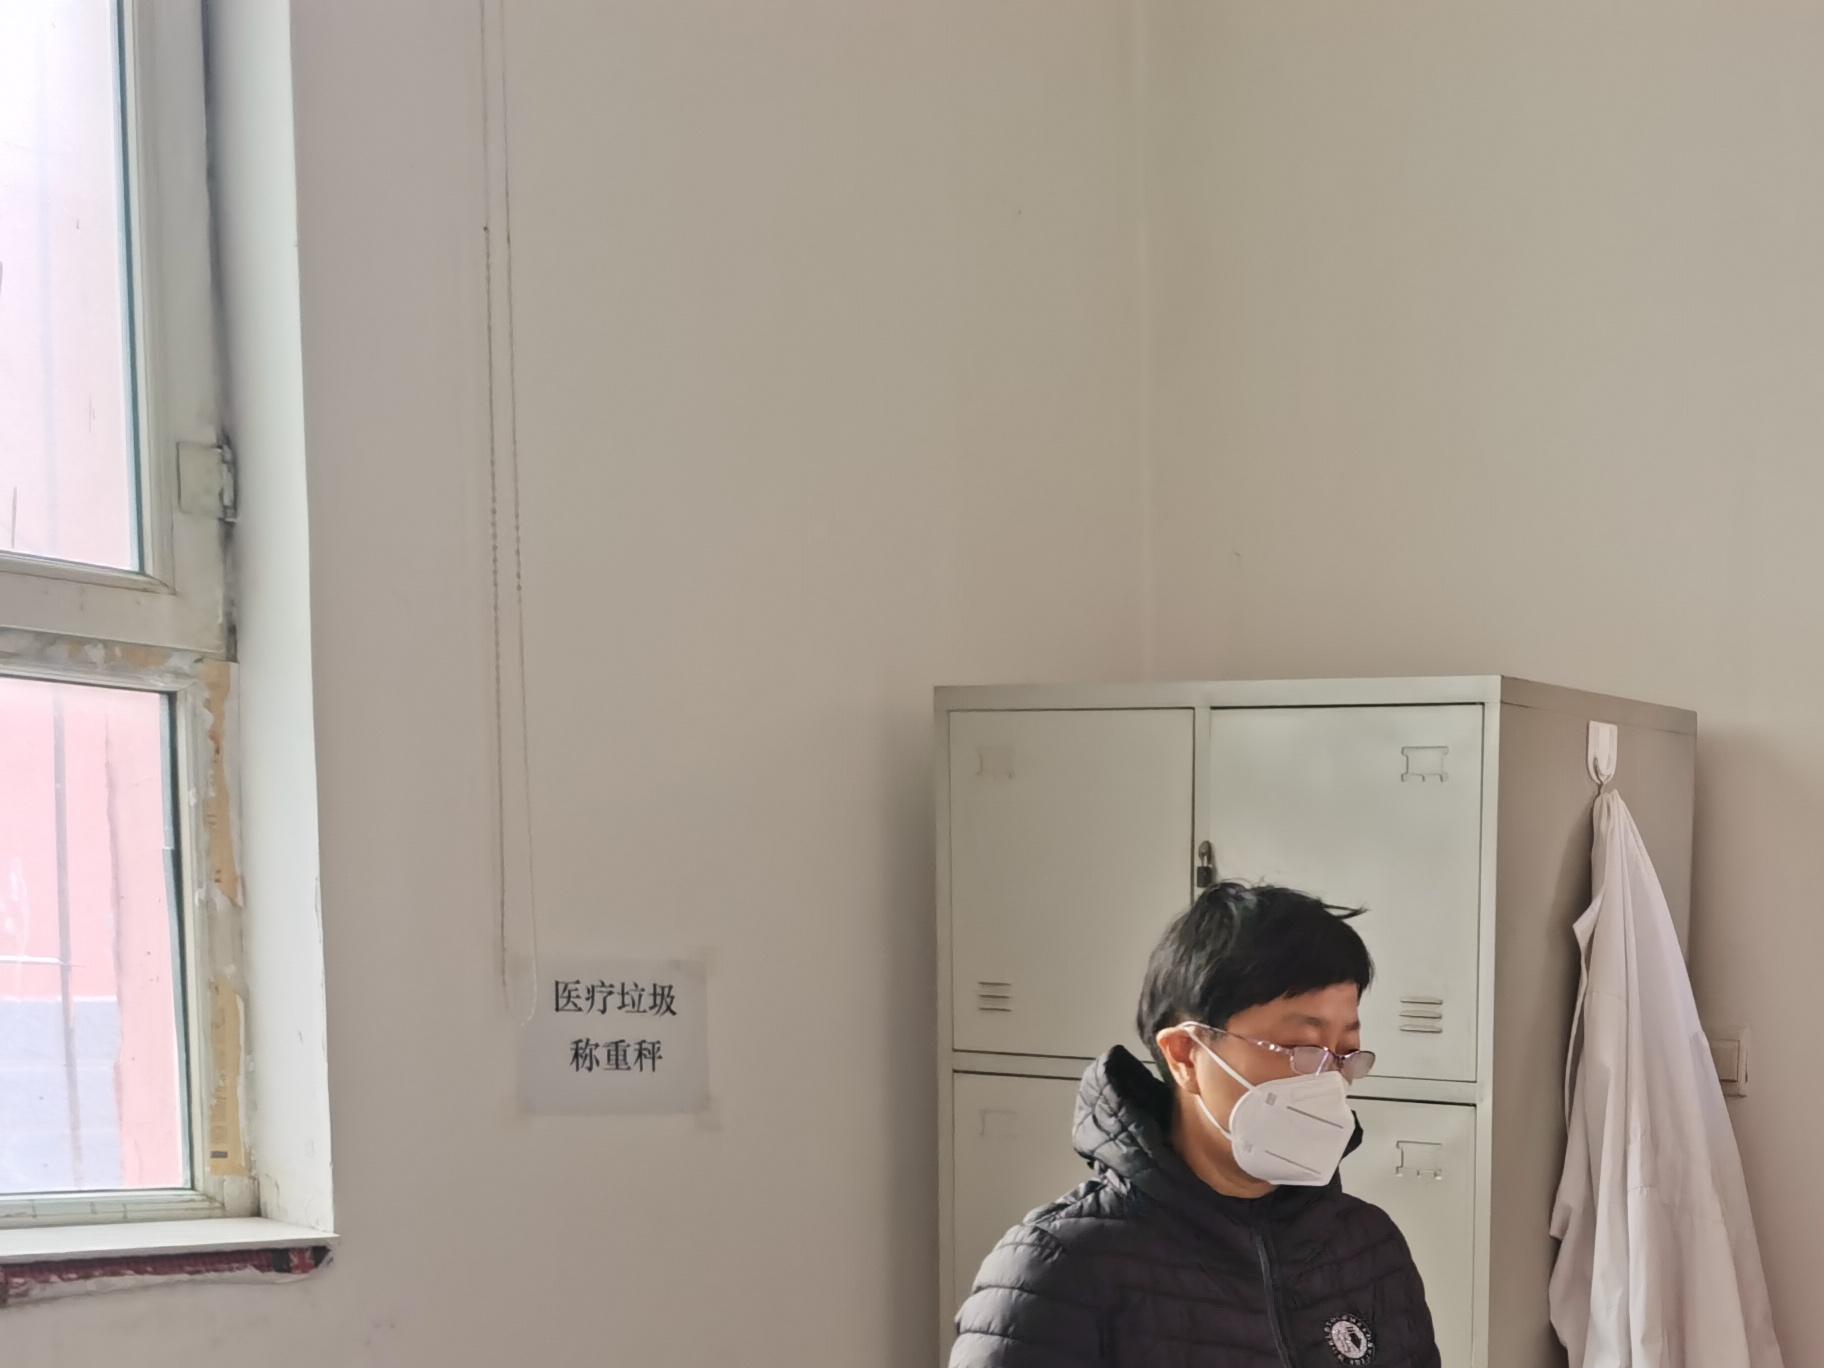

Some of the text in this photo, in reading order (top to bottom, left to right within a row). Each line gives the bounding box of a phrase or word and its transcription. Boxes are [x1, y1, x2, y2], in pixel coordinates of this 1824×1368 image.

[554, 979, 678, 1016] 医疗垃圾
[569, 1037, 664, 1073] 称重秤
